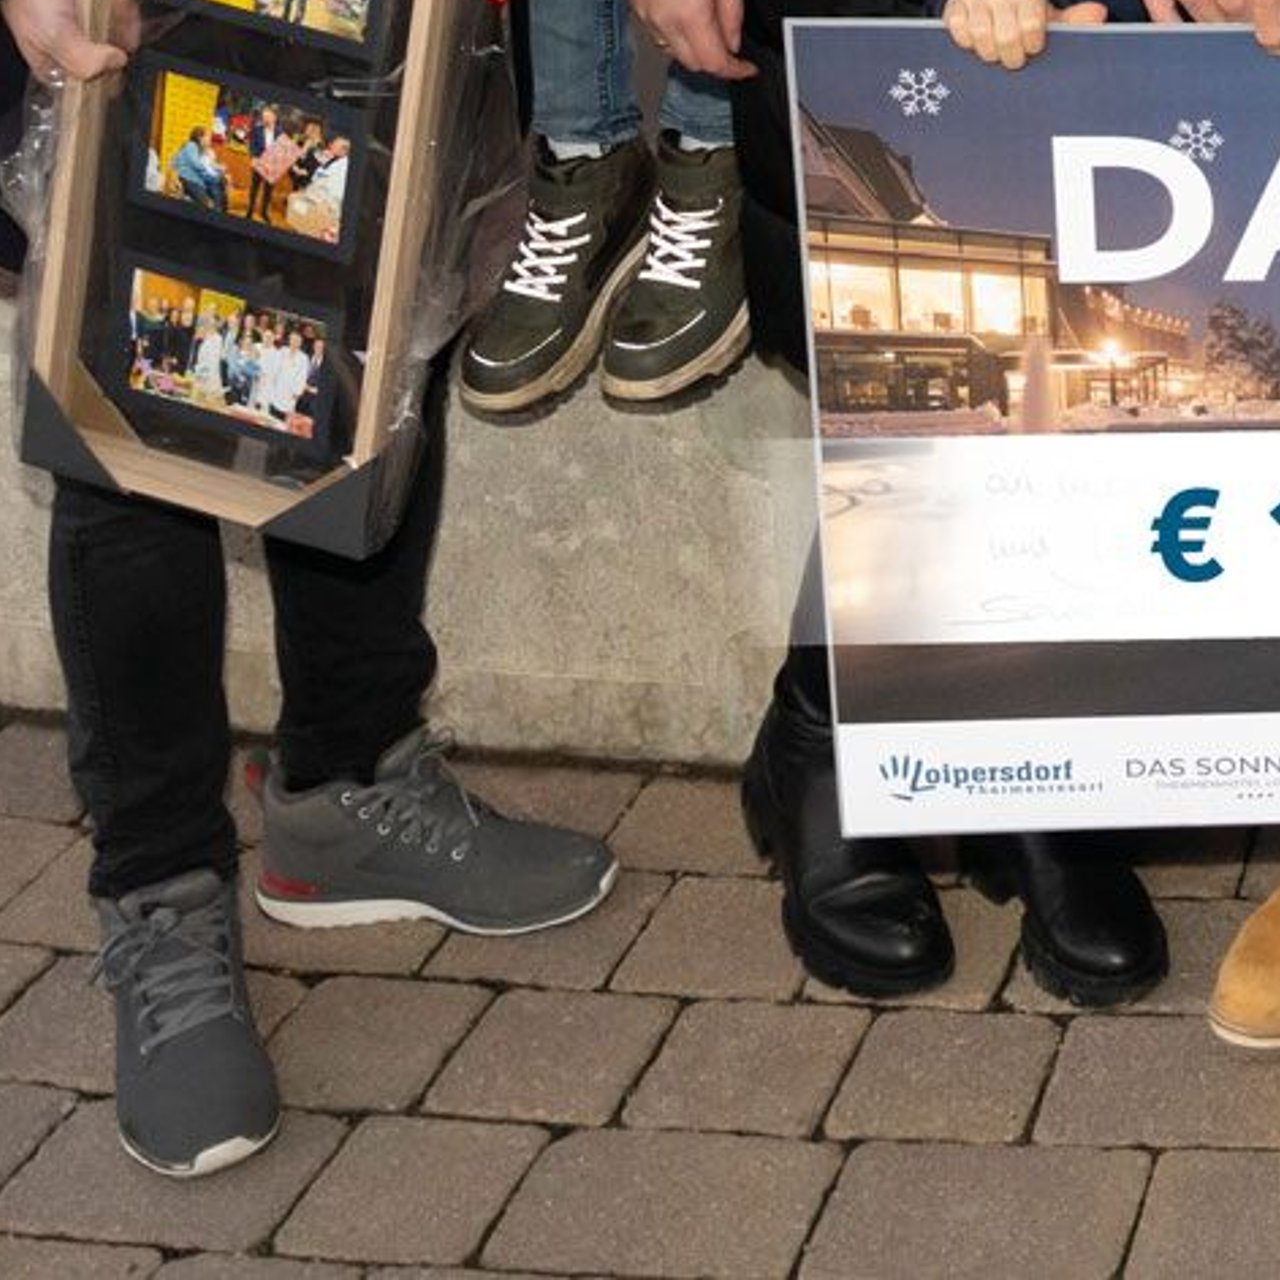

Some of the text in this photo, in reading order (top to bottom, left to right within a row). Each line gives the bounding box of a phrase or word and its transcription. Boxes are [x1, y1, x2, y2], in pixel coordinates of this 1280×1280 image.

[1151, 487, 1224, 583] €
[909, 758, 1073, 792] Loipersdorf
[1125, 758, 1186, 778] DAS
